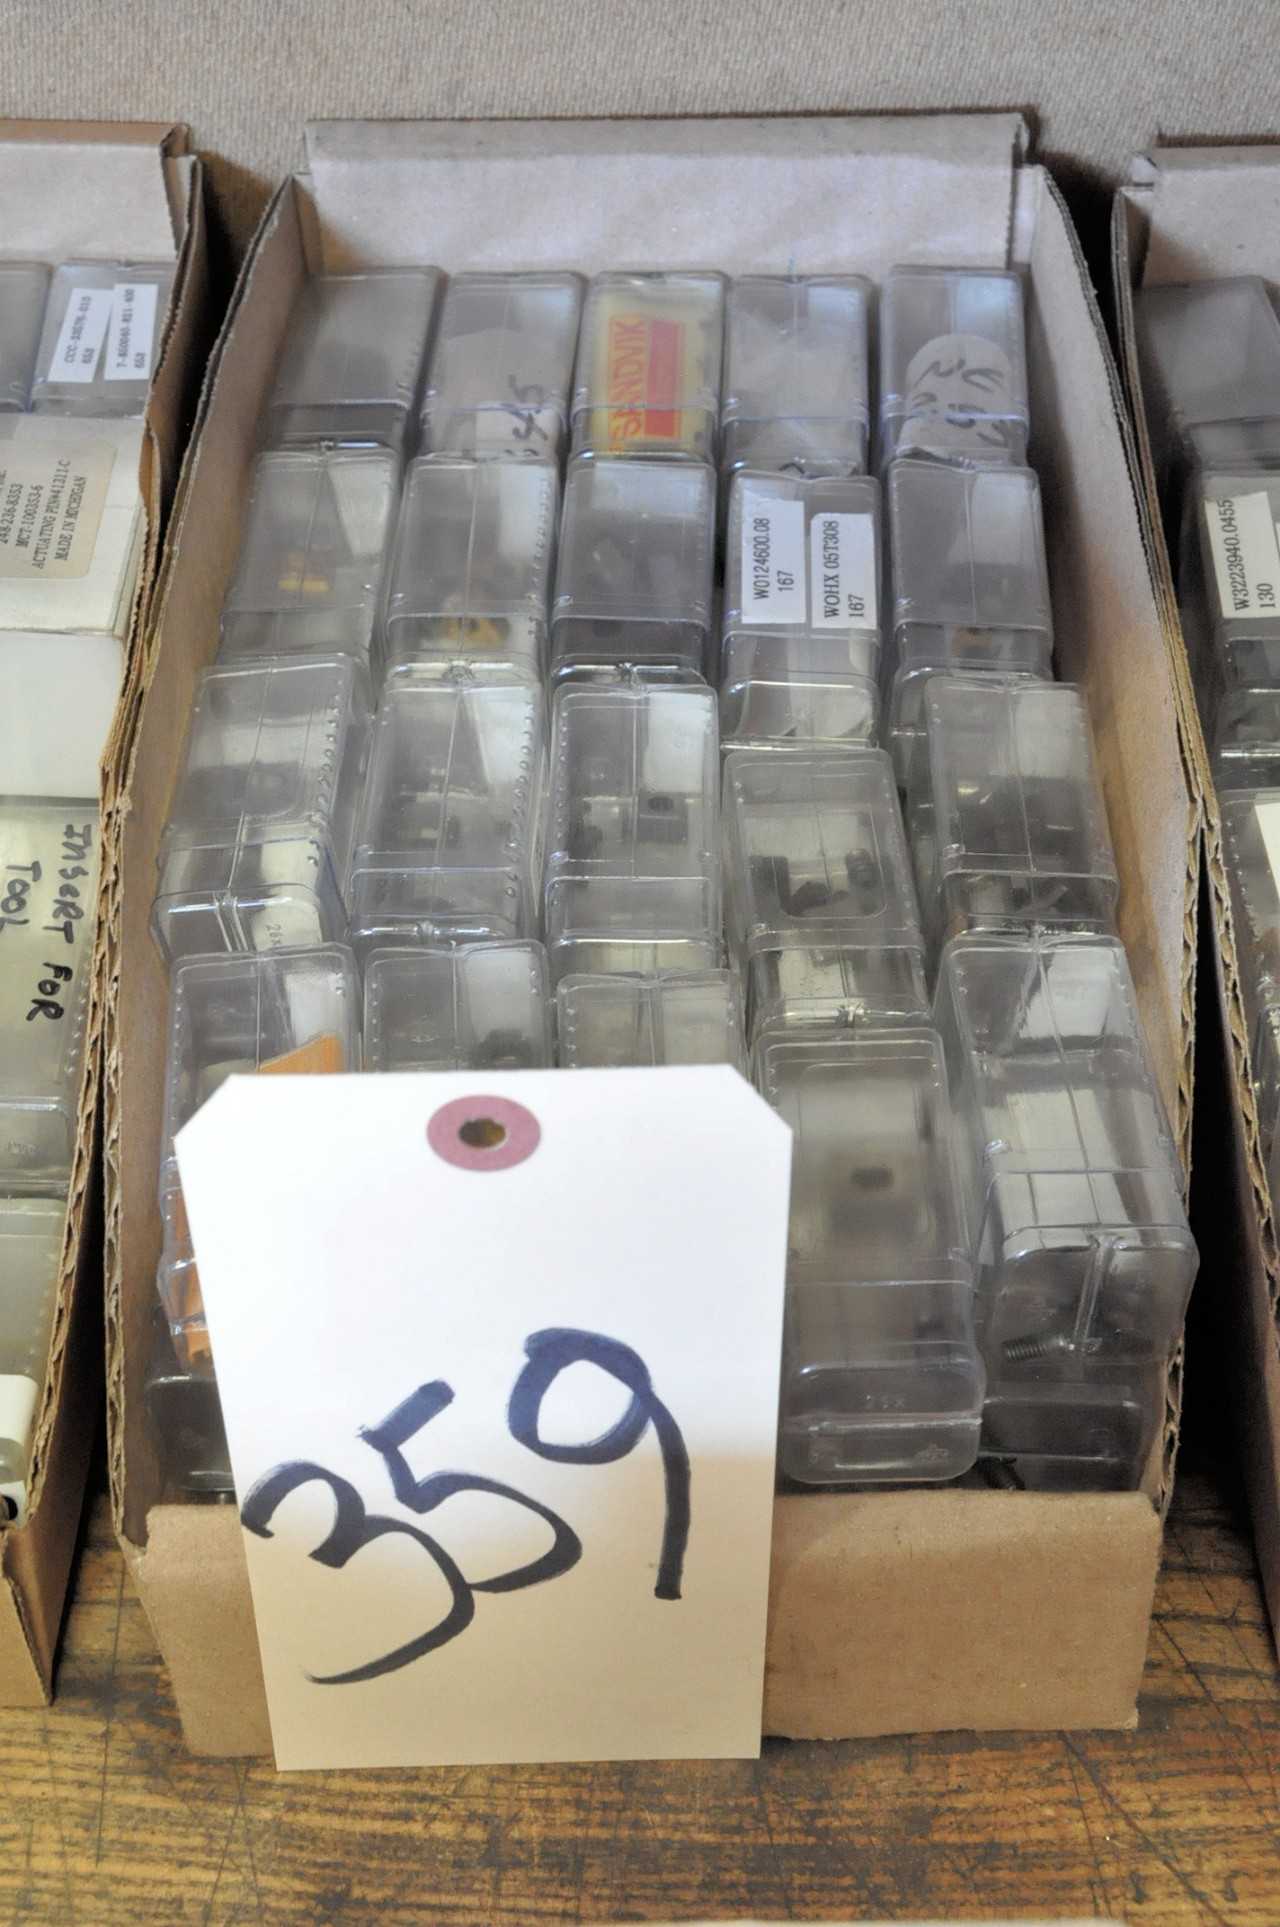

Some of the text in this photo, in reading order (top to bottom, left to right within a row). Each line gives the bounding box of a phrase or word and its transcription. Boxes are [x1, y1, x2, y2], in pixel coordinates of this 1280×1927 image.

[32, 515, 57, 570] ACTUATING
[54, 475, 87, 561] MADE IN MICHIGAN
[823, 520, 840, 570] 05T308
[753, 517, 771, 600] W0124600.08
[777, 570, 795, 593] 167
[1217, 499, 1250, 612] W3223940.0455
[848, 594, 865, 618] 167
[1255, 583, 1277, 609] 130
[26, 961, 74, 1022] FOR
[240, 1326, 693, 1685] 359
